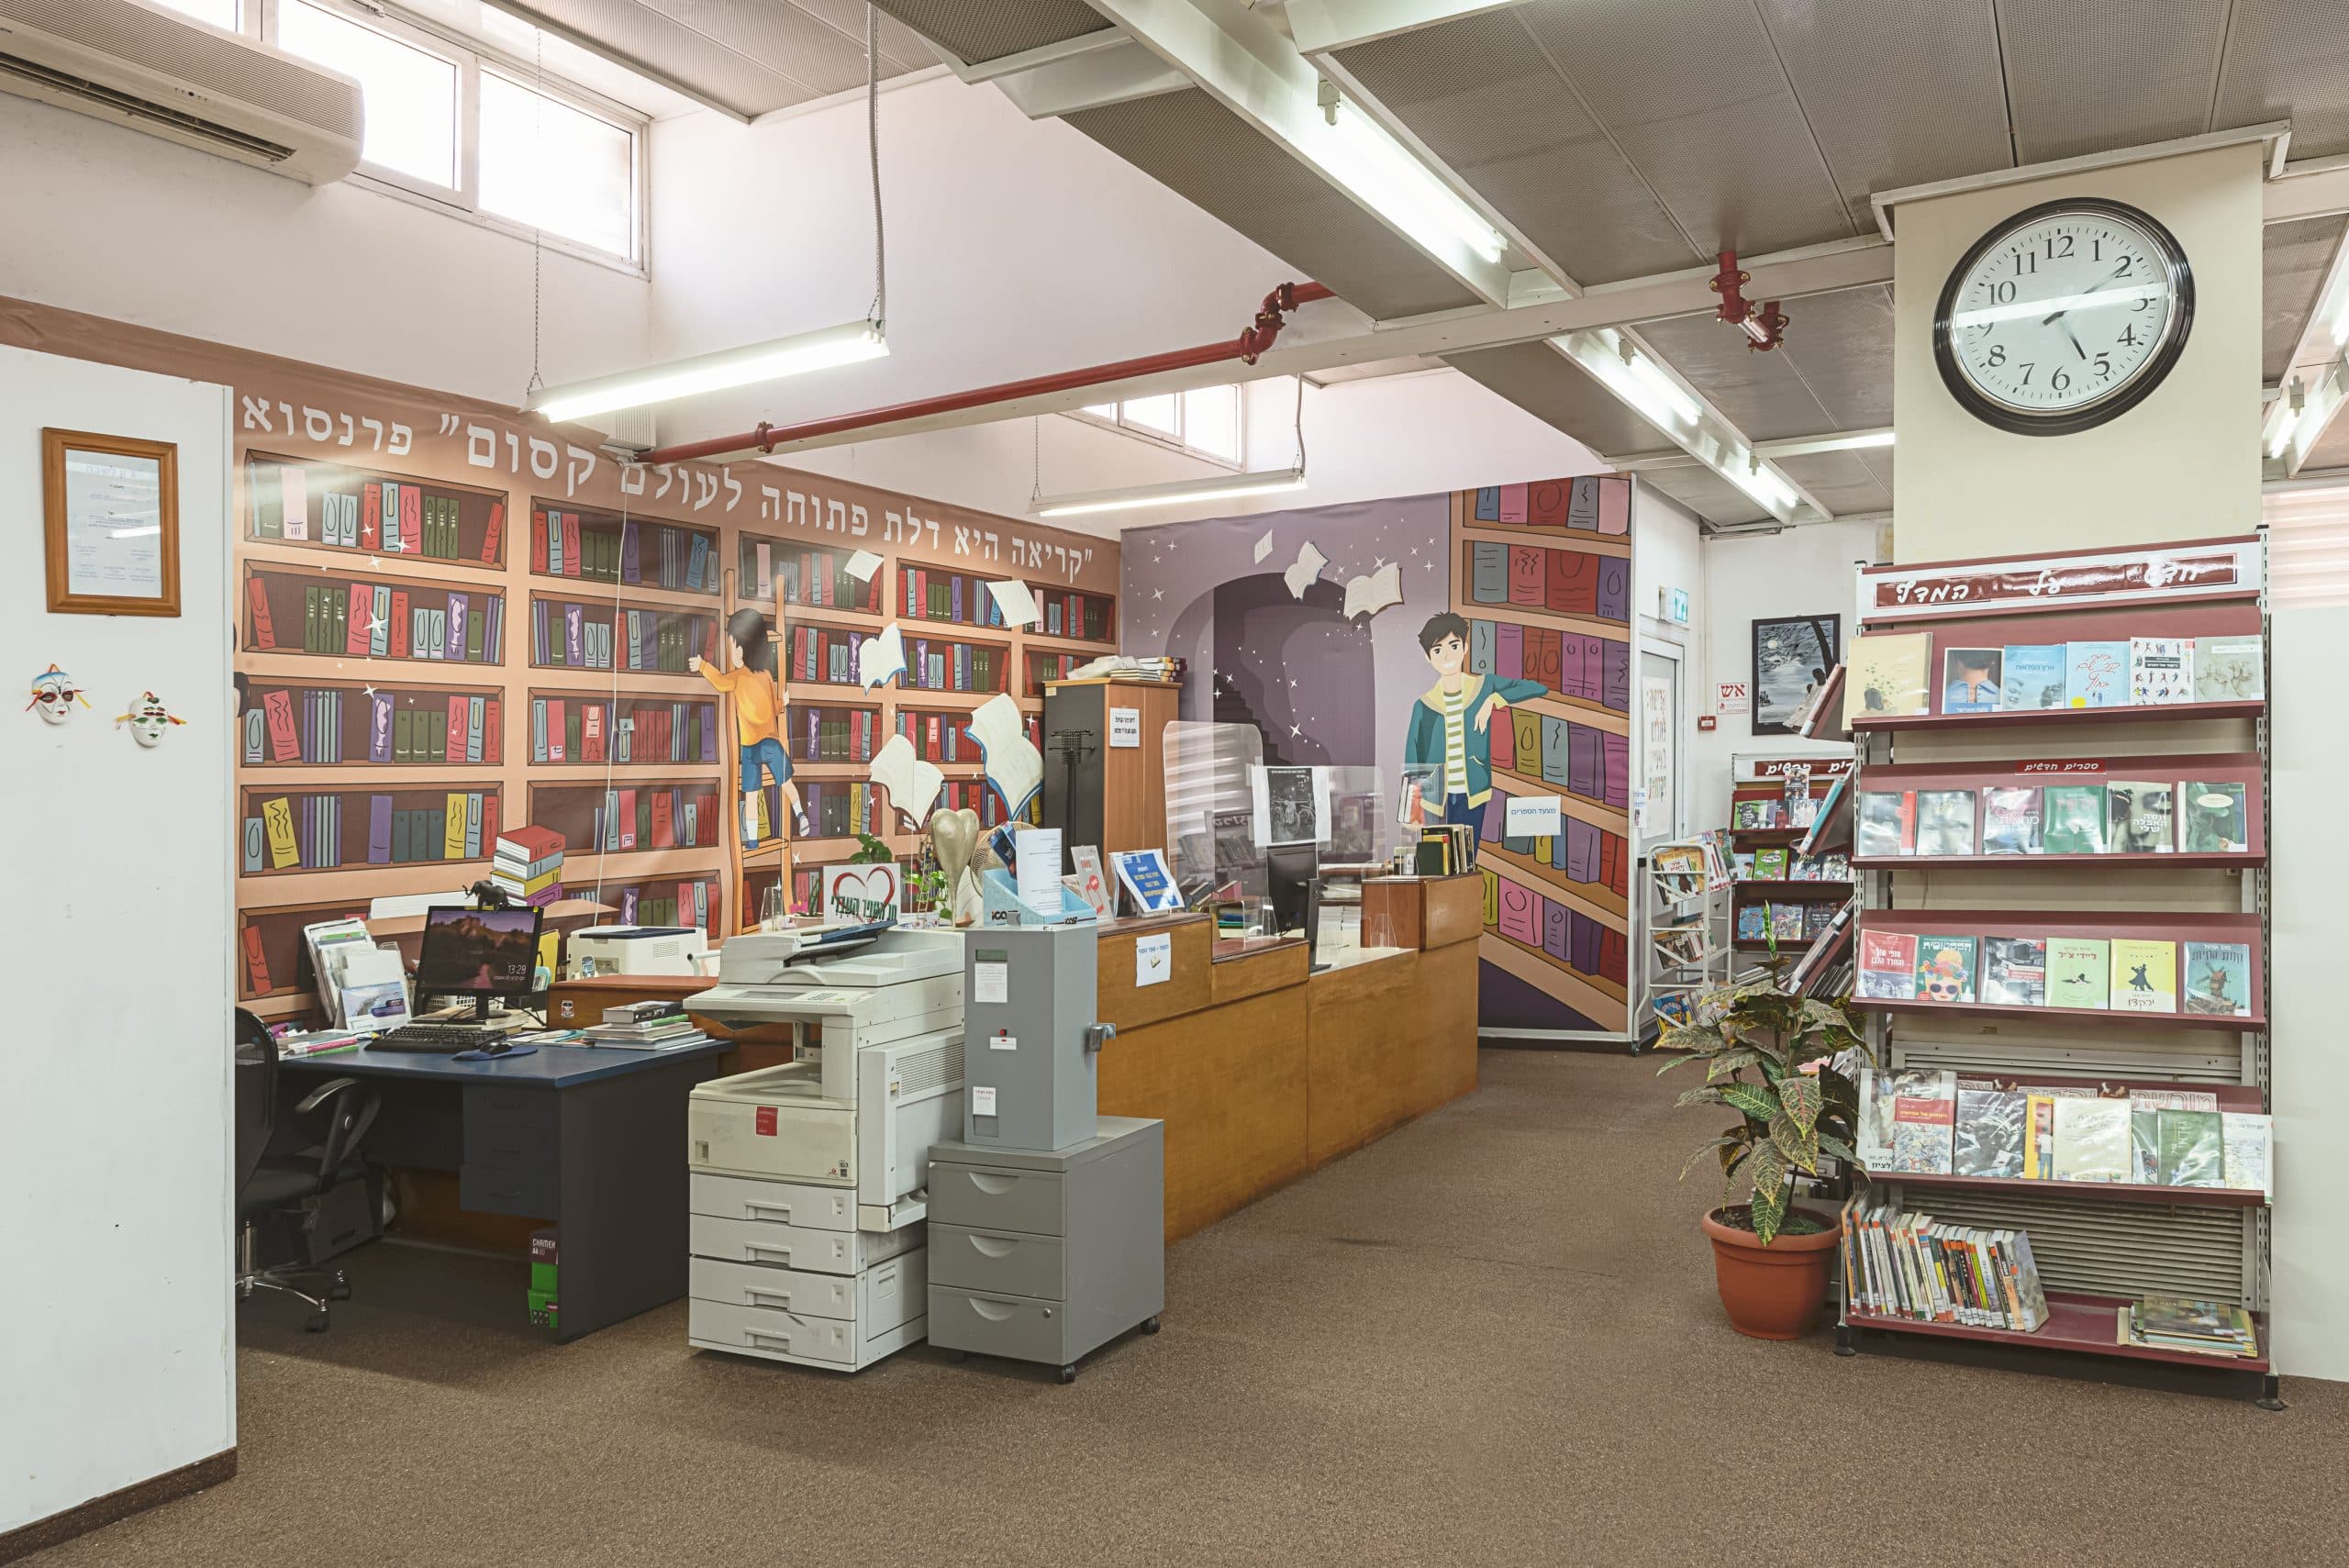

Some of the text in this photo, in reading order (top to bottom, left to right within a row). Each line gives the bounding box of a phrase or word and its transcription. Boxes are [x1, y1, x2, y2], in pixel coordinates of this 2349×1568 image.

[2043, 235, 2075, 260] 12
[2091, 239, 2102, 261] 1
[2013, 252, 2038, 276] 11
[2114, 255, 2132, 279] 2
[1988, 280, 2017, 306] 10
[2117, 323, 2137, 346] 4
[1987, 344, 2007, 367] 8
[2093, 351, 2110, 376] 5
[2019, 362, 2036, 385] 7
[2051, 366, 2071, 391] 6
[242, 395, 414, 456] פרנסוא
[620, 462, 743, 512] לעולם
[762, 484, 870, 535] פתוחה
[885, 507, 940, 549] דלת
[954, 524, 998, 562] היא
[1896, 579, 1969, 604] המדף
[1720, 684, 1745, 698] אש
[2023, 761, 2099, 773] ספרים חדשים
[2131, 1090, 2216, 1111] מורשת
